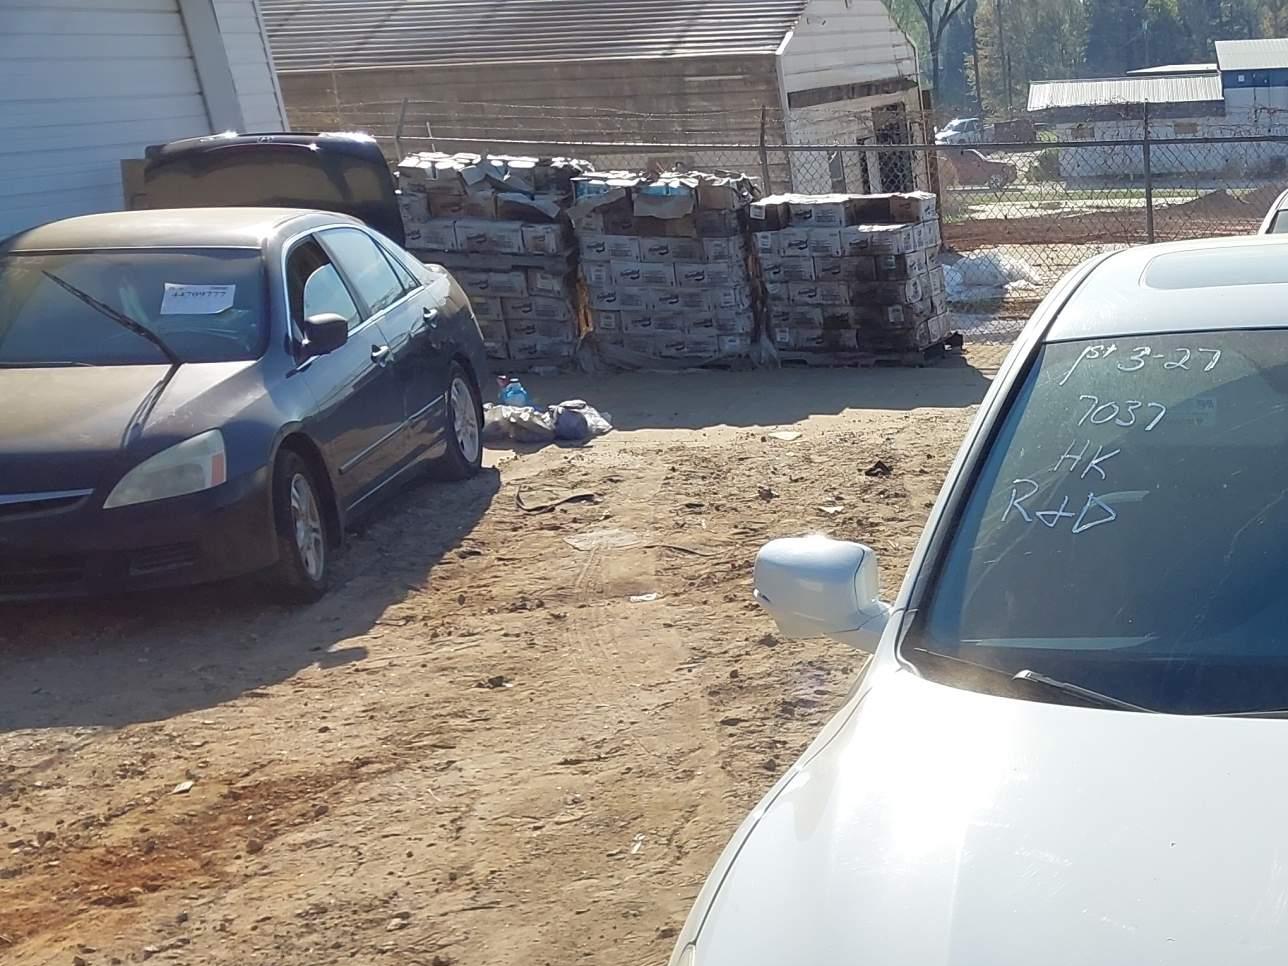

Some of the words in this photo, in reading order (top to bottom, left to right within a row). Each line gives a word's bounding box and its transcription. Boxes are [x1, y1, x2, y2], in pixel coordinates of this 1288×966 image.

[1117, 345, 1222, 372] 3-27
[1077, 394, 1167, 431] 7037
[1053, 439, 1121, 479] HK
